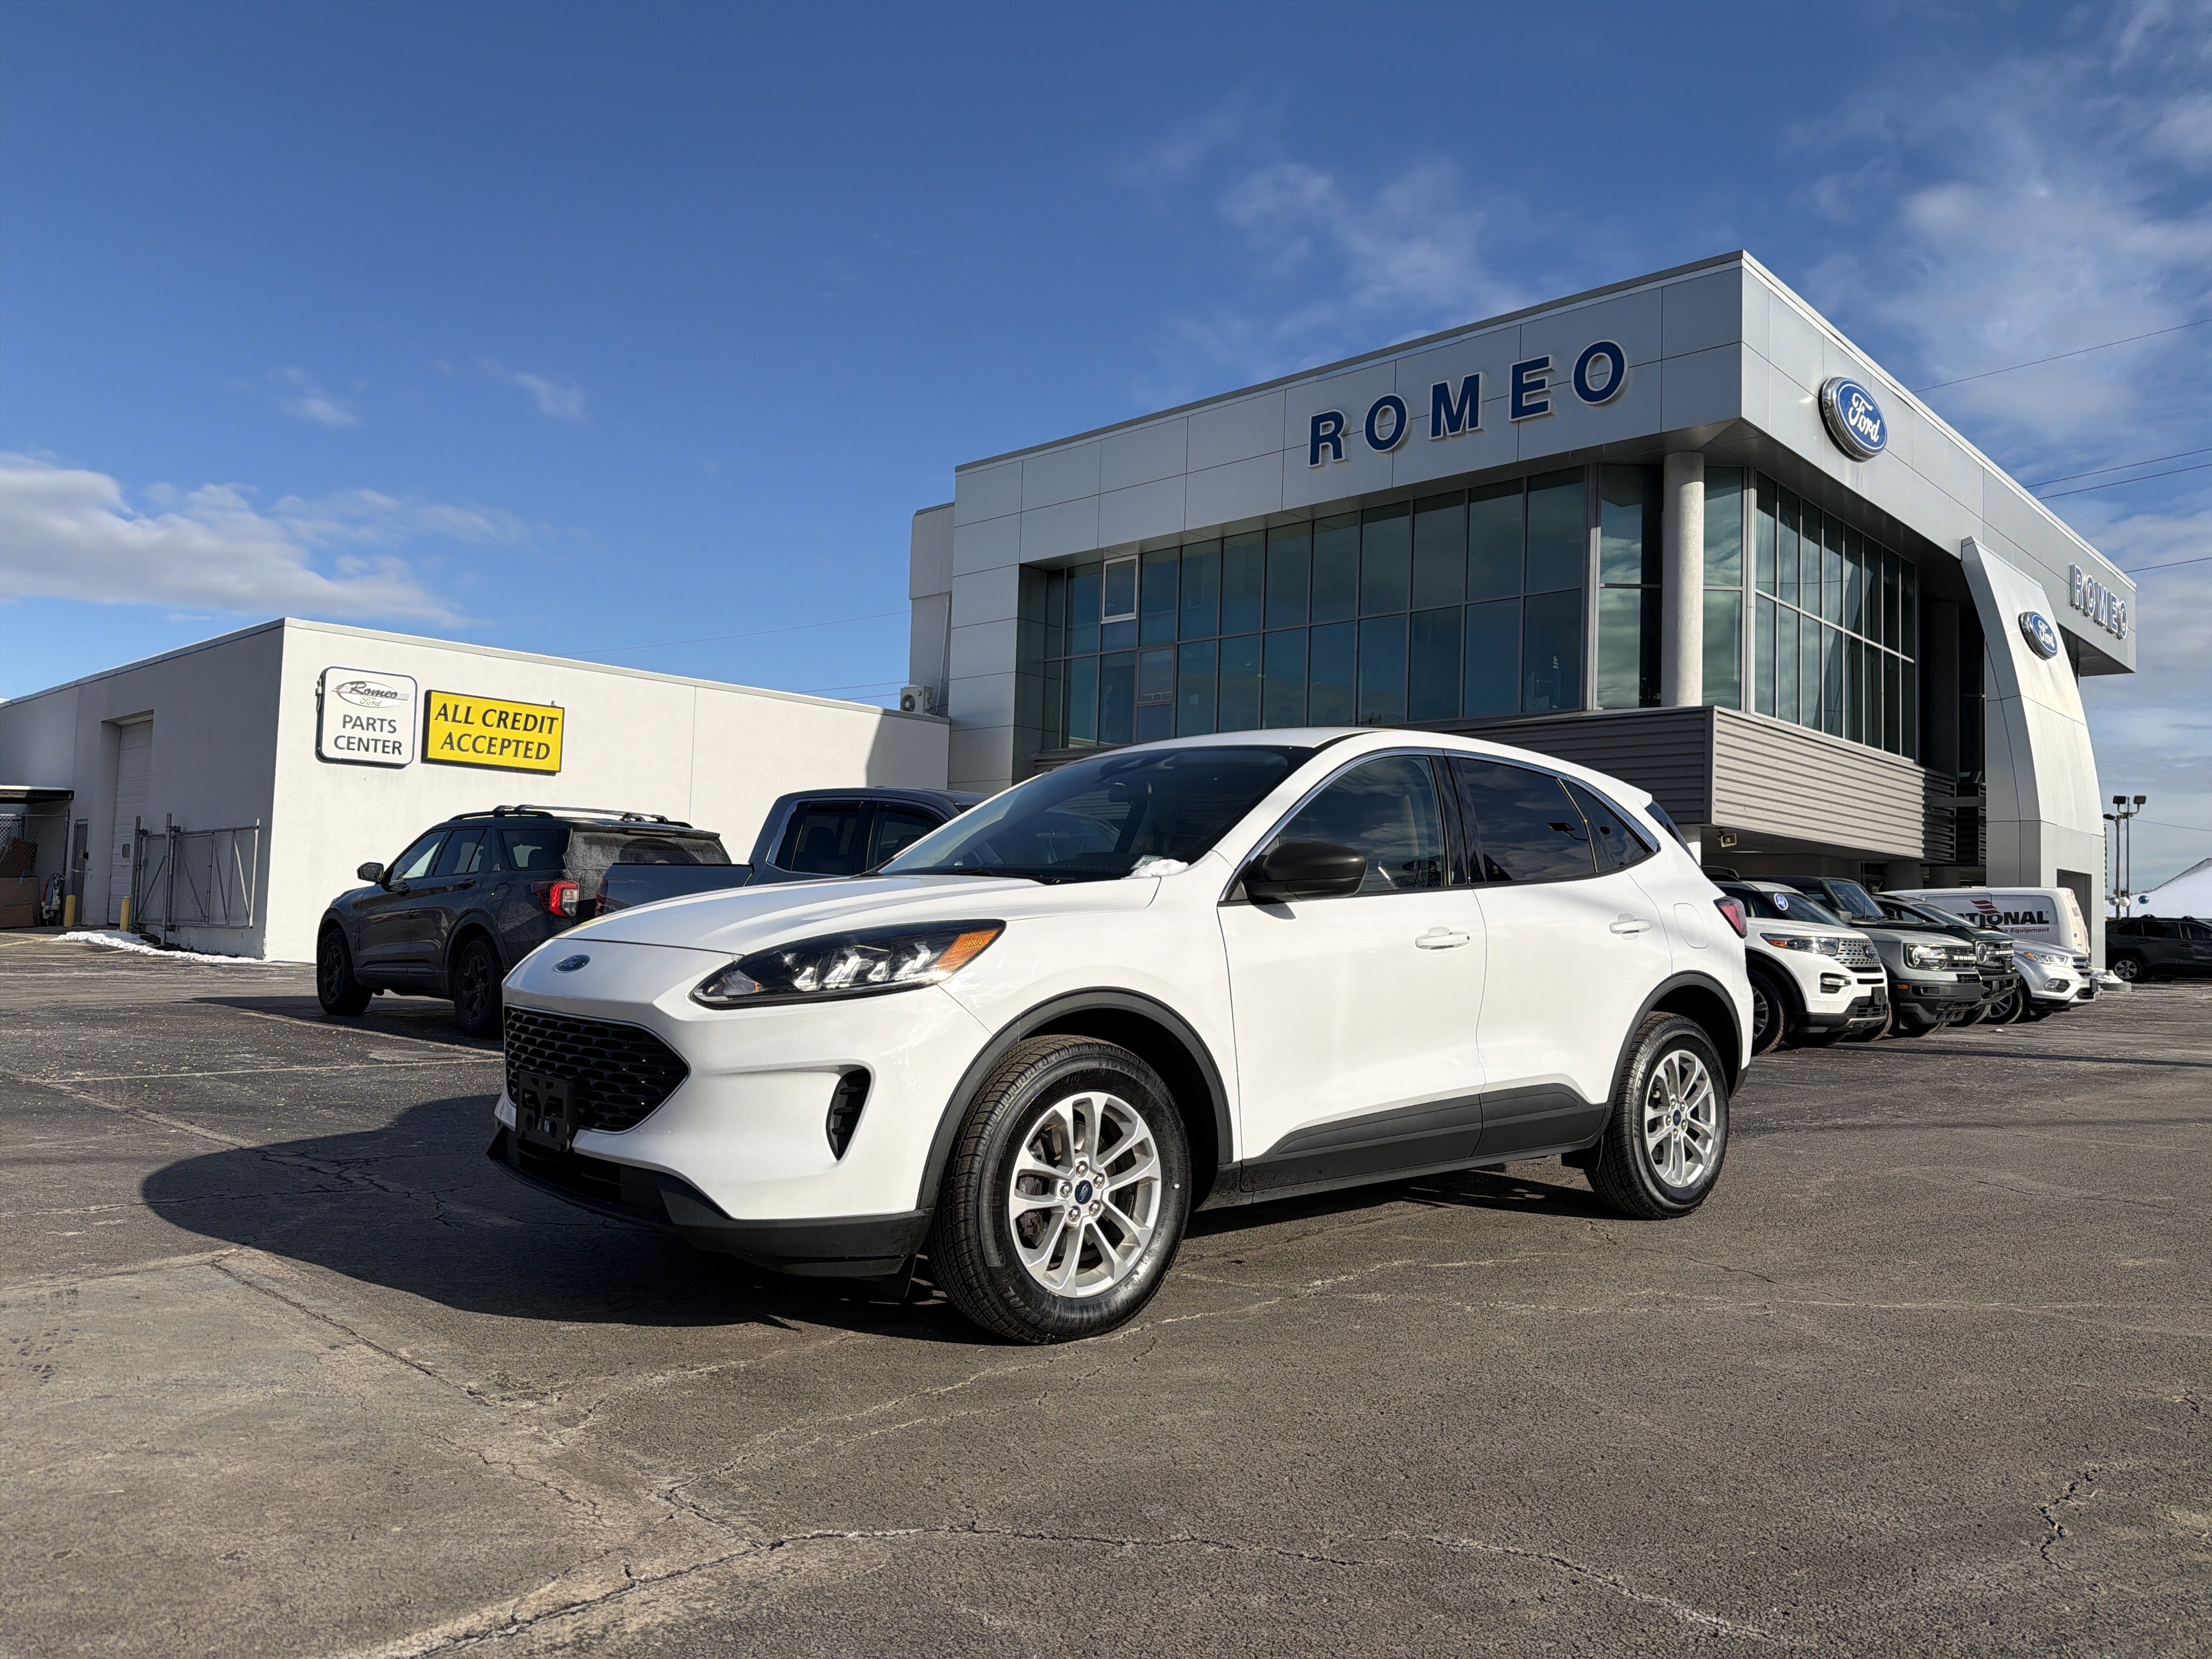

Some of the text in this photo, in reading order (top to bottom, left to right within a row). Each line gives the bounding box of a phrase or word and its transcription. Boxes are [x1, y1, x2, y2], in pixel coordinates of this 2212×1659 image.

[1308, 338, 1628, 468] ROMEO
[1848, 392, 1880, 443] Ford
[2070, 563, 2128, 640] ROMEO
[2038, 619, 2055, 649] Ford
[349, 681, 398, 698] Romeo
[359, 696, 382, 707] Ford
[342, 714, 397, 734] PARTS
[434, 702, 559, 735] ALL CREDIT
[333, 735, 403, 756] CENTER
[439, 731, 551, 761] ACCEPTED
[1956, 911, 2050, 927] TIONAL
